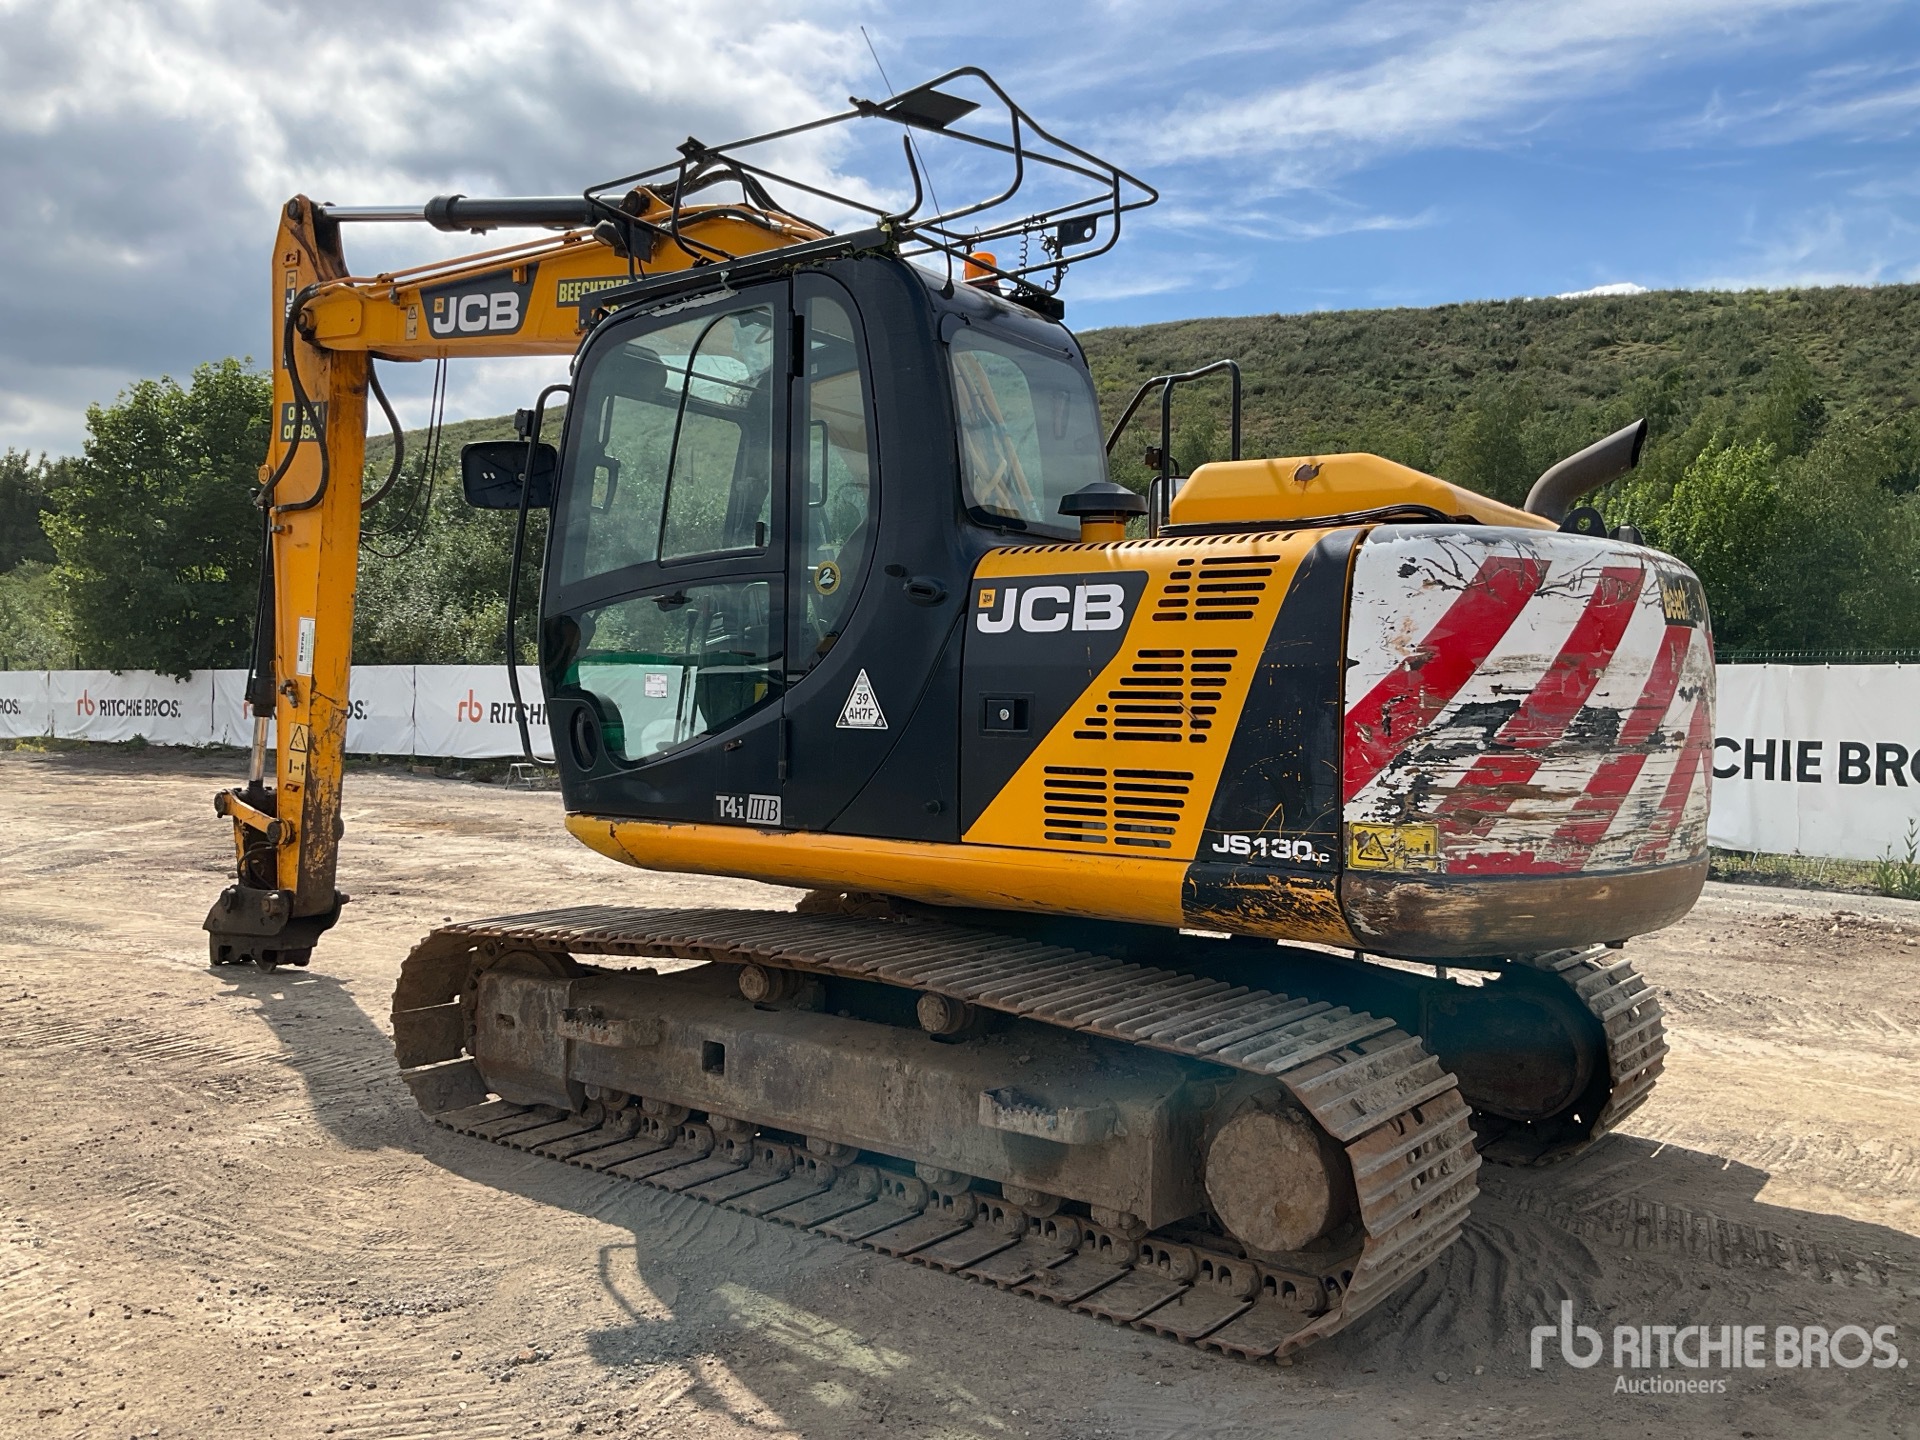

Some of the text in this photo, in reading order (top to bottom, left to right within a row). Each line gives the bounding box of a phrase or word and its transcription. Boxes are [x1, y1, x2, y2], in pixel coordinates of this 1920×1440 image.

[433, 291, 520, 333] JCB
[976, 583, 1125, 634] JCB
[99, 699, 142, 717] RITCHIE
[144, 699, 182, 718] BROS.
[856, 693, 869, 705] 39
[490, 702, 548, 725] RITCHI
[848, 708, 875, 720] AH7F
[1713, 737, 1920, 787] CHIE BR
[715, 795, 746, 819] T4i
